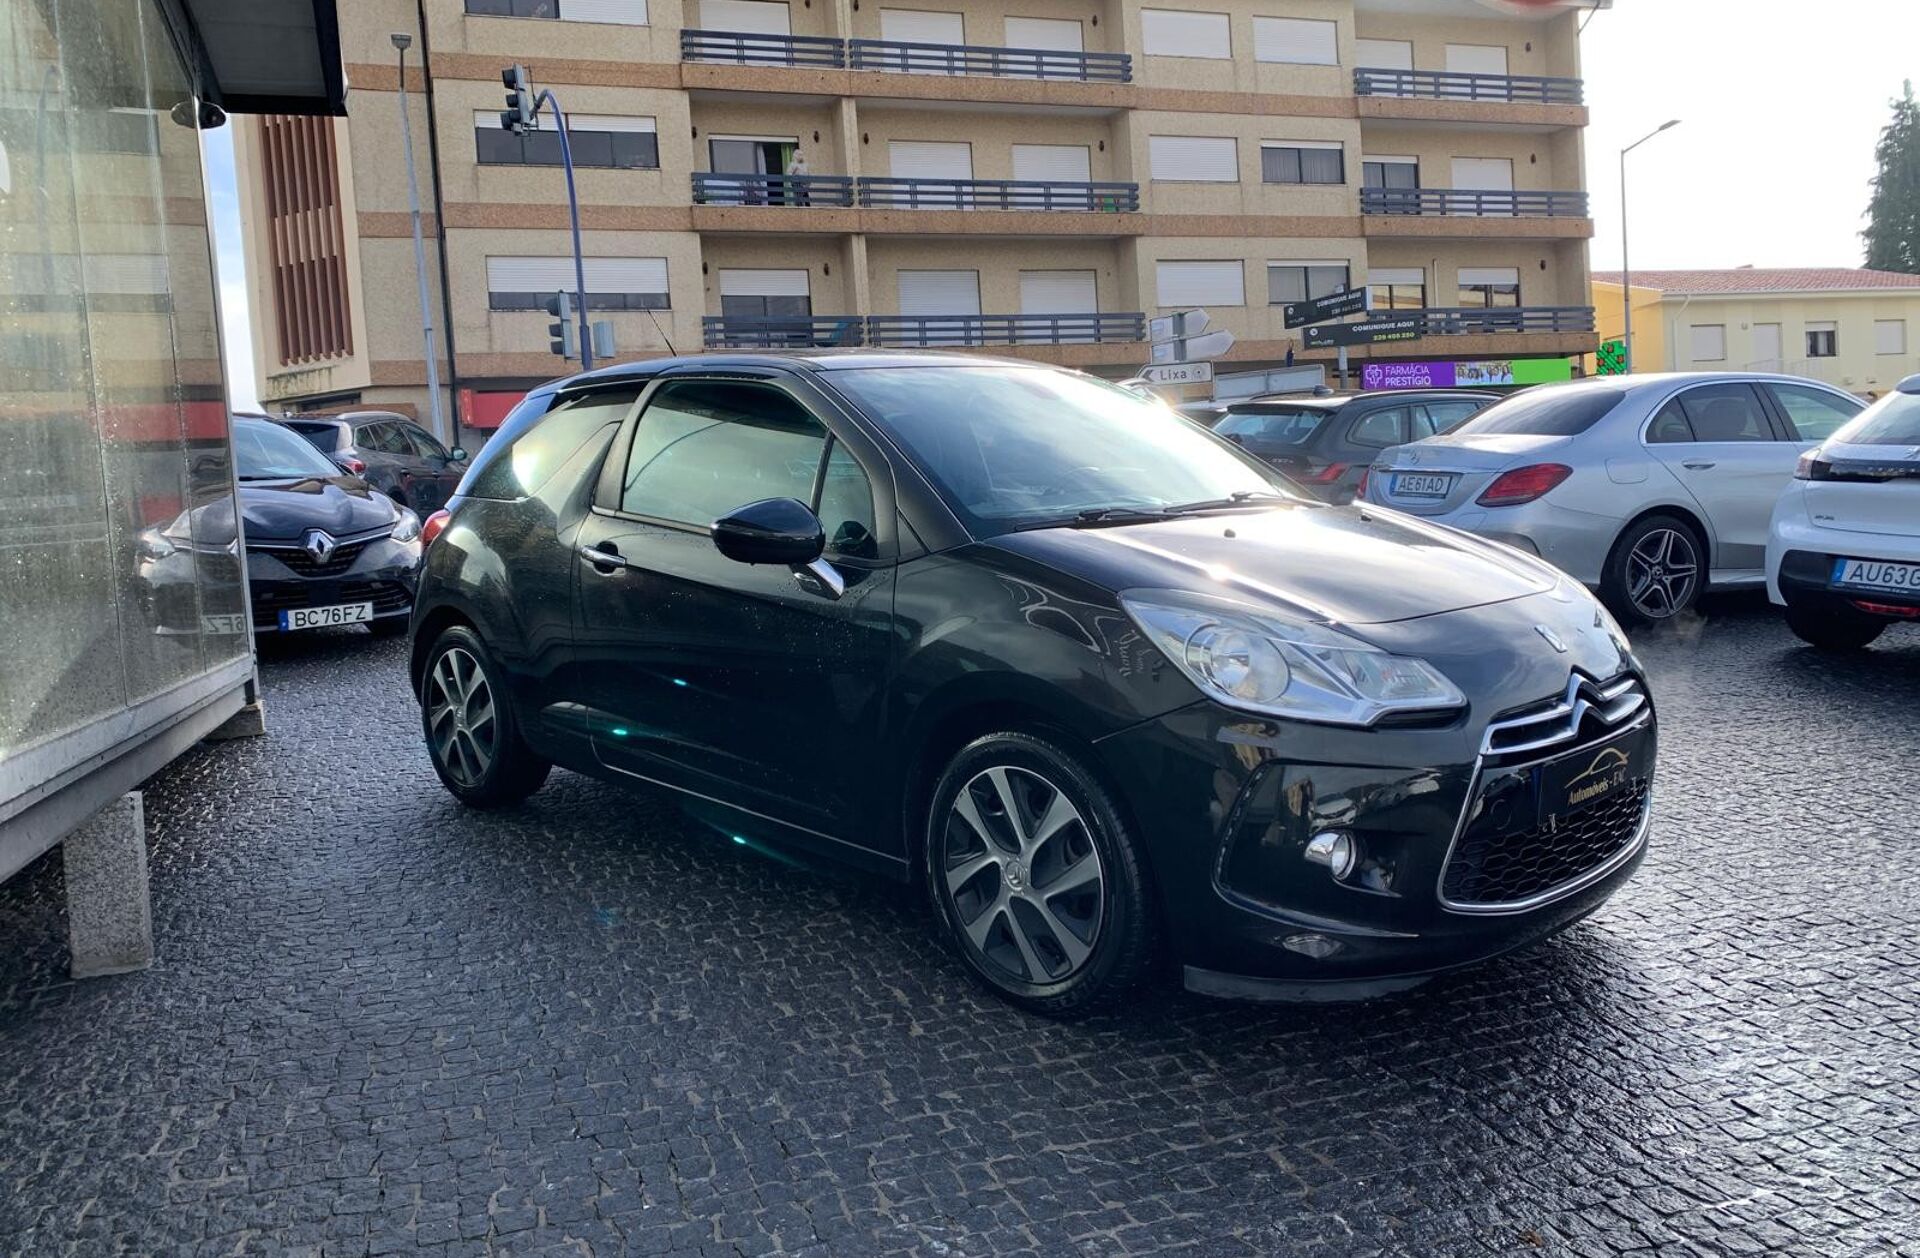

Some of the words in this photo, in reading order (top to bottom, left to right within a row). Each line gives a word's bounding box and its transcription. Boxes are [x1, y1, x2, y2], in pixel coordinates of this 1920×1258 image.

[1352, 322, 1396, 332] COMUNIQUE
[1397, 321, 1415, 329] AQUI
[1160, 369, 1188, 381] Lixa
[1385, 363, 1430, 376] FARMÁCIA
[294, 604, 366, 627] BC76FZ
